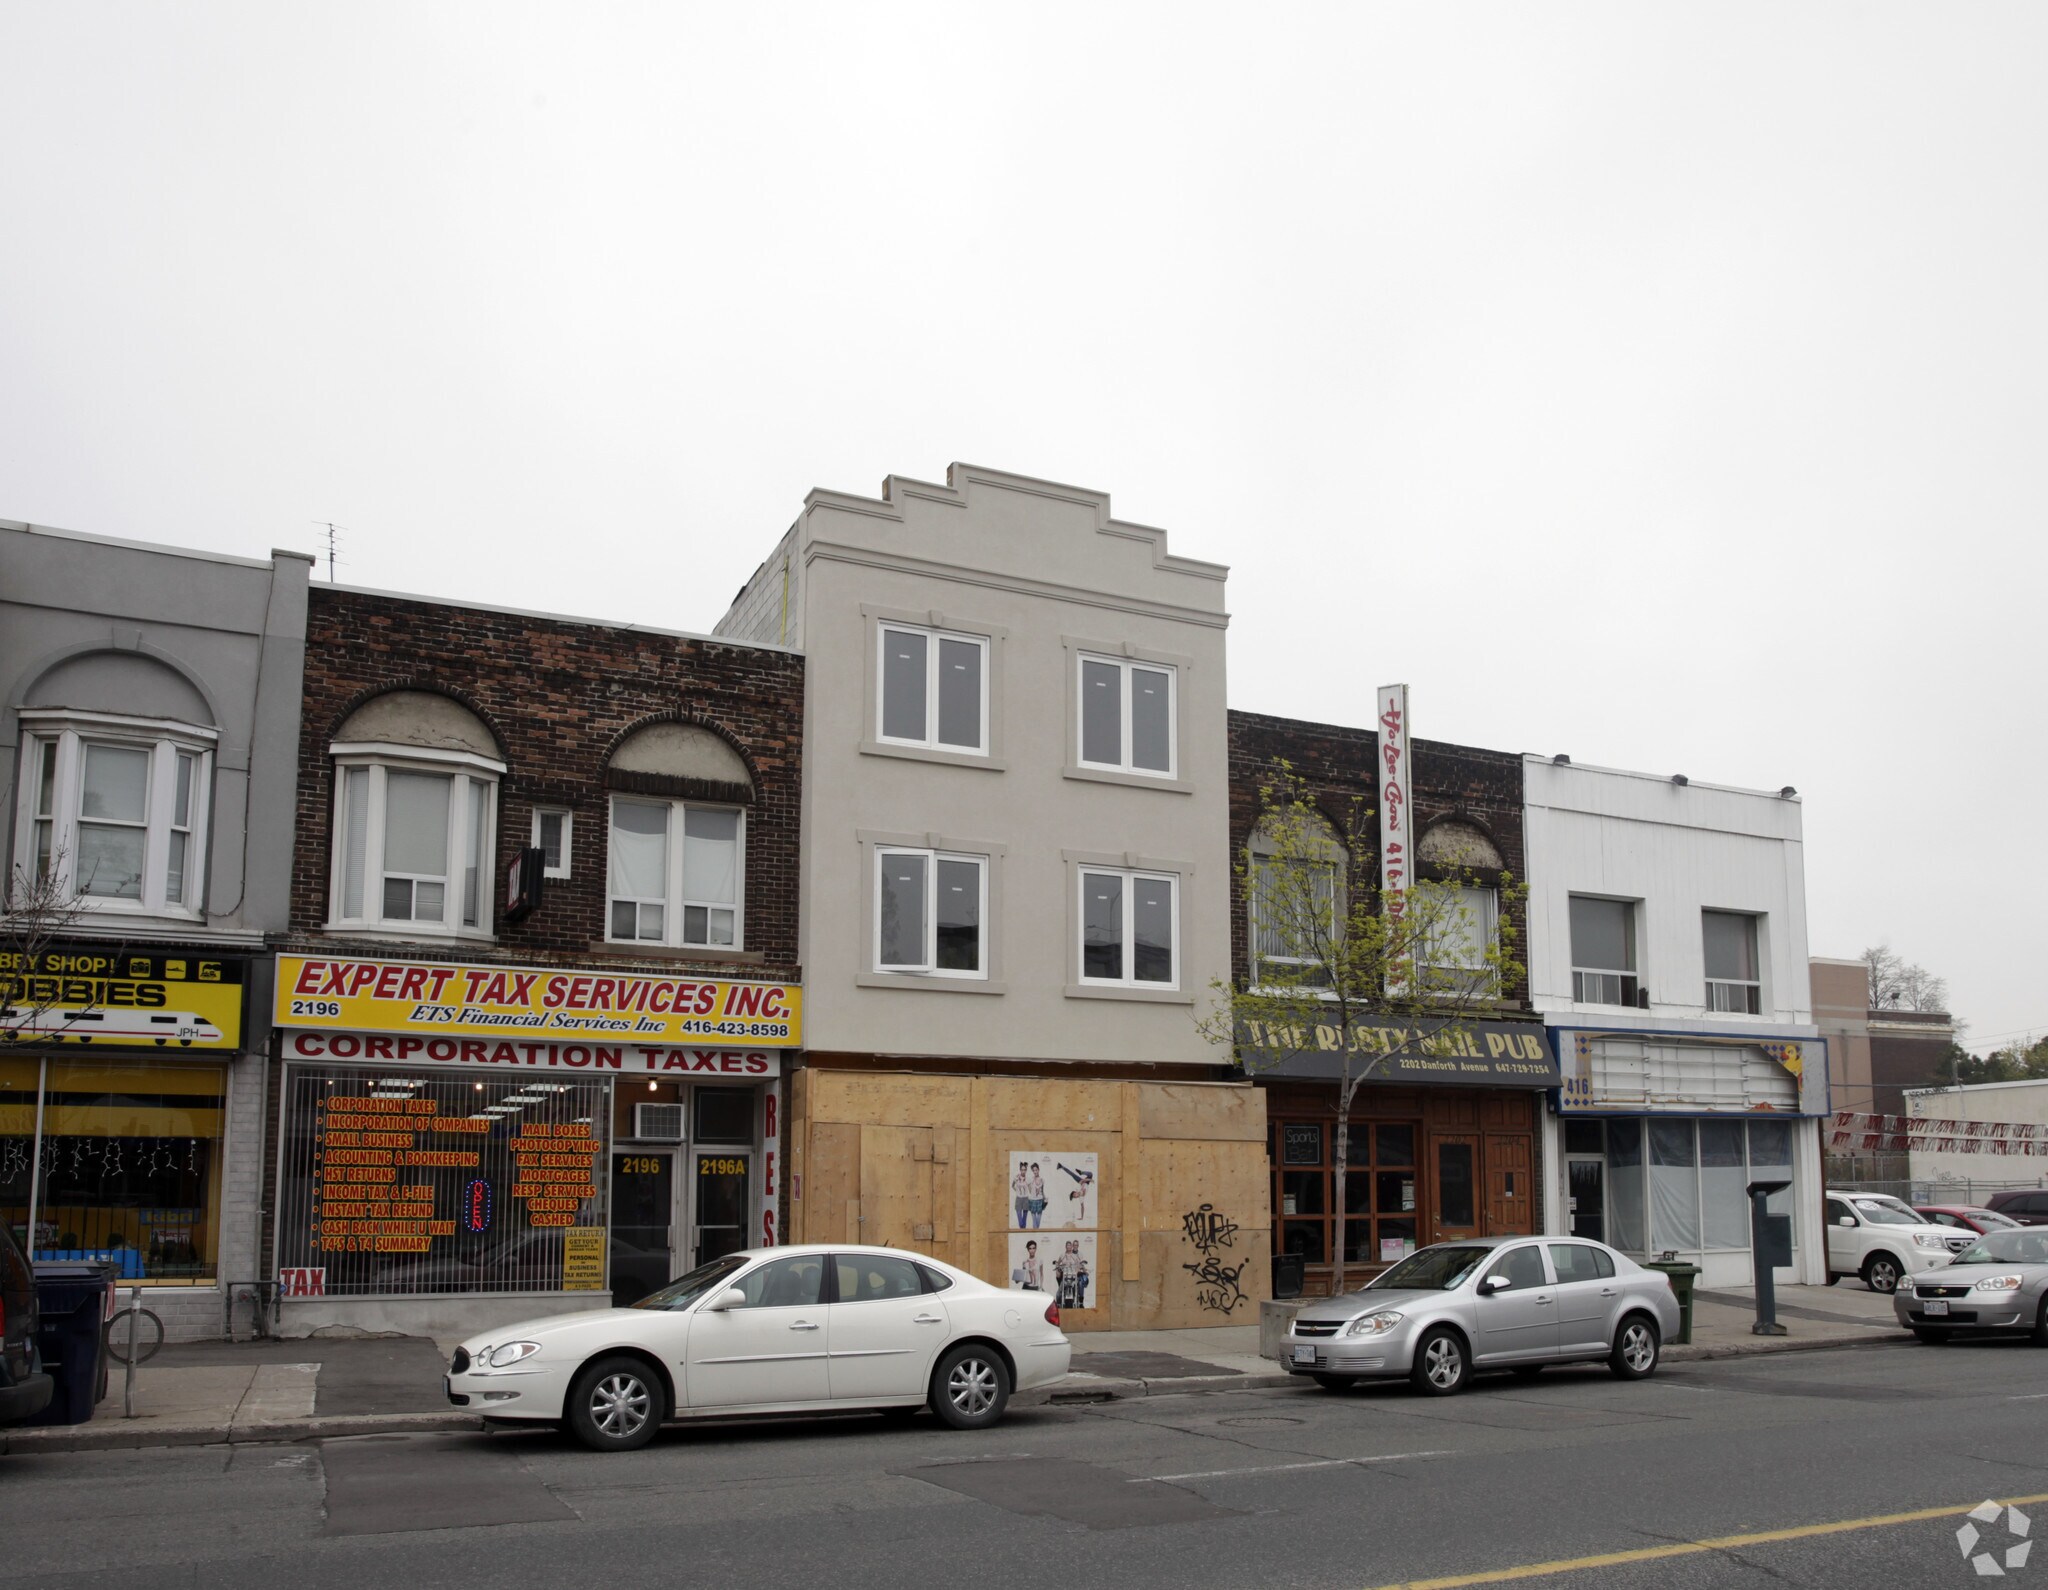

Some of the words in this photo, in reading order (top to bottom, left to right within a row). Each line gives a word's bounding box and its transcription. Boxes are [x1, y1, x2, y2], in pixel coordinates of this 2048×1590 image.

[46, 954, 115, 973] SHOP!
[293, 961, 455, 1001] EXPERT
[464, 971, 538, 1006] TAX
[543, 975, 718, 1015] SERVICES
[723, 986, 791, 1018] INC.
[292, 1001, 339, 1016] 2196
[409, 1005, 456, 1022] ETS
[456, 1008, 549, 1027] Financial
[551, 1012, 631, 1031] Services
[634, 1016, 665, 1033] Inc
[176, 1028, 199, 1037] JPH
[682, 1020, 789, 1037] 416-423-8598
[294, 1033, 622, 1069] CORPORATION
[638, 1049, 769, 1074] TAXES
[1485, 1032, 1544, 1060] PUB
[1400, 1059, 1420, 1069] 2202
[1421, 1059, 1457, 1071] Danforth
[1460, 1062, 1489, 1072] Avenue
[326, 1096, 403, 1113] CORPORATION
[404, 1099, 436, 1114] TAXES
[326, 1114, 413, 1131] INCORPORATION
[415, 1117, 430, 1131] OF
[431, 1118, 490, 1133] COMPANIES
[521, 1123, 550, 1137] MAIL
[554, 1124, 590, 1138] BOXES
[325, 1132, 360, 1147] SMALL
[362, 1133, 413, 1148] BUSINESS
[1286, 1129, 1318, 1144] Sports
[510, 1139, 600, 1152] PHOTOCOPYING
[324, 1150, 393, 1165] ACCOUNTING
[394, 1152, 404, 1165] &
[406, 1152, 479, 1166] BOOKKEEPING
[516, 1153, 539, 1167] FAX
[540, 1153, 593, 1167] SERVICES
[623, 1158, 659, 1174] 2196
[324, 1167, 345, 1182] HST
[347, 1168, 395, 1183] RETURNS
[701, 1159, 745, 1175] 2196A
[519, 1169, 590, 1183] MORTGAGES
[323, 1185, 366, 1200] INCOME
[368, 1185, 389, 1200] TAX
[390, 1185, 400, 1200] &
[402, 1185, 434, 1200] E-FILE
[512, 1184, 542, 1197] RESP
[544, 1184, 597, 1198] SERVICES
[322, 1202, 367, 1217] INSTANT
[369, 1203, 391, 1217] TAX
[392, 1203, 434, 1218] REFUND
[472, 1181, 483, 1229] OPEN
[527, 1198, 579, 1212] CHEQUES
[147, 1210, 193, 1222] kibri
[530, 1213, 575, 1227] CASHED
[321, 1220, 351, 1236] CASH
[352, 1220, 380, 1236] BACK
[381, 1220, 418, 1236] WHILE
[418, 1220, 427, 1236] U
[428, 1221, 456, 1236] WAIT
[321, 1236, 346, 1251] T4'S
[347, 1237, 356, 1251] &
[359, 1237, 374, 1251] T4
[375, 1236, 433, 1252] SUMMARY
[281, 1269, 324, 1297] TAX
